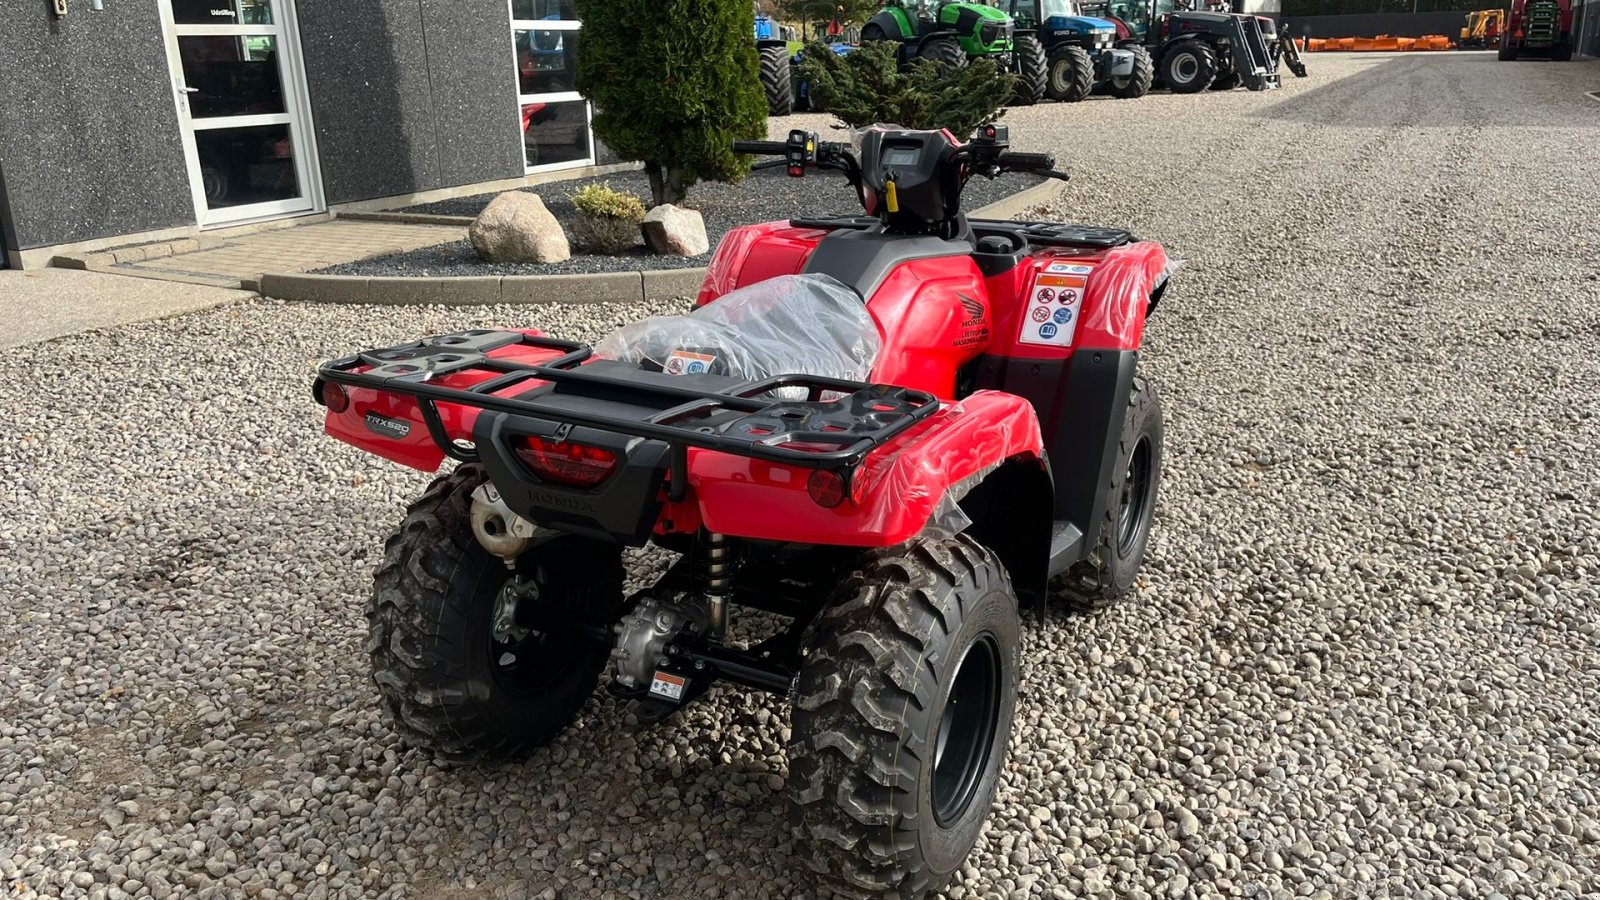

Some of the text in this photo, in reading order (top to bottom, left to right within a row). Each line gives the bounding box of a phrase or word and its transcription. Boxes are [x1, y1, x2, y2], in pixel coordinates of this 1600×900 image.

[962, 318, 986, 328] HONDA
[365, 414, 410, 433] TRX520
[527, 489, 596, 513] HONDA
